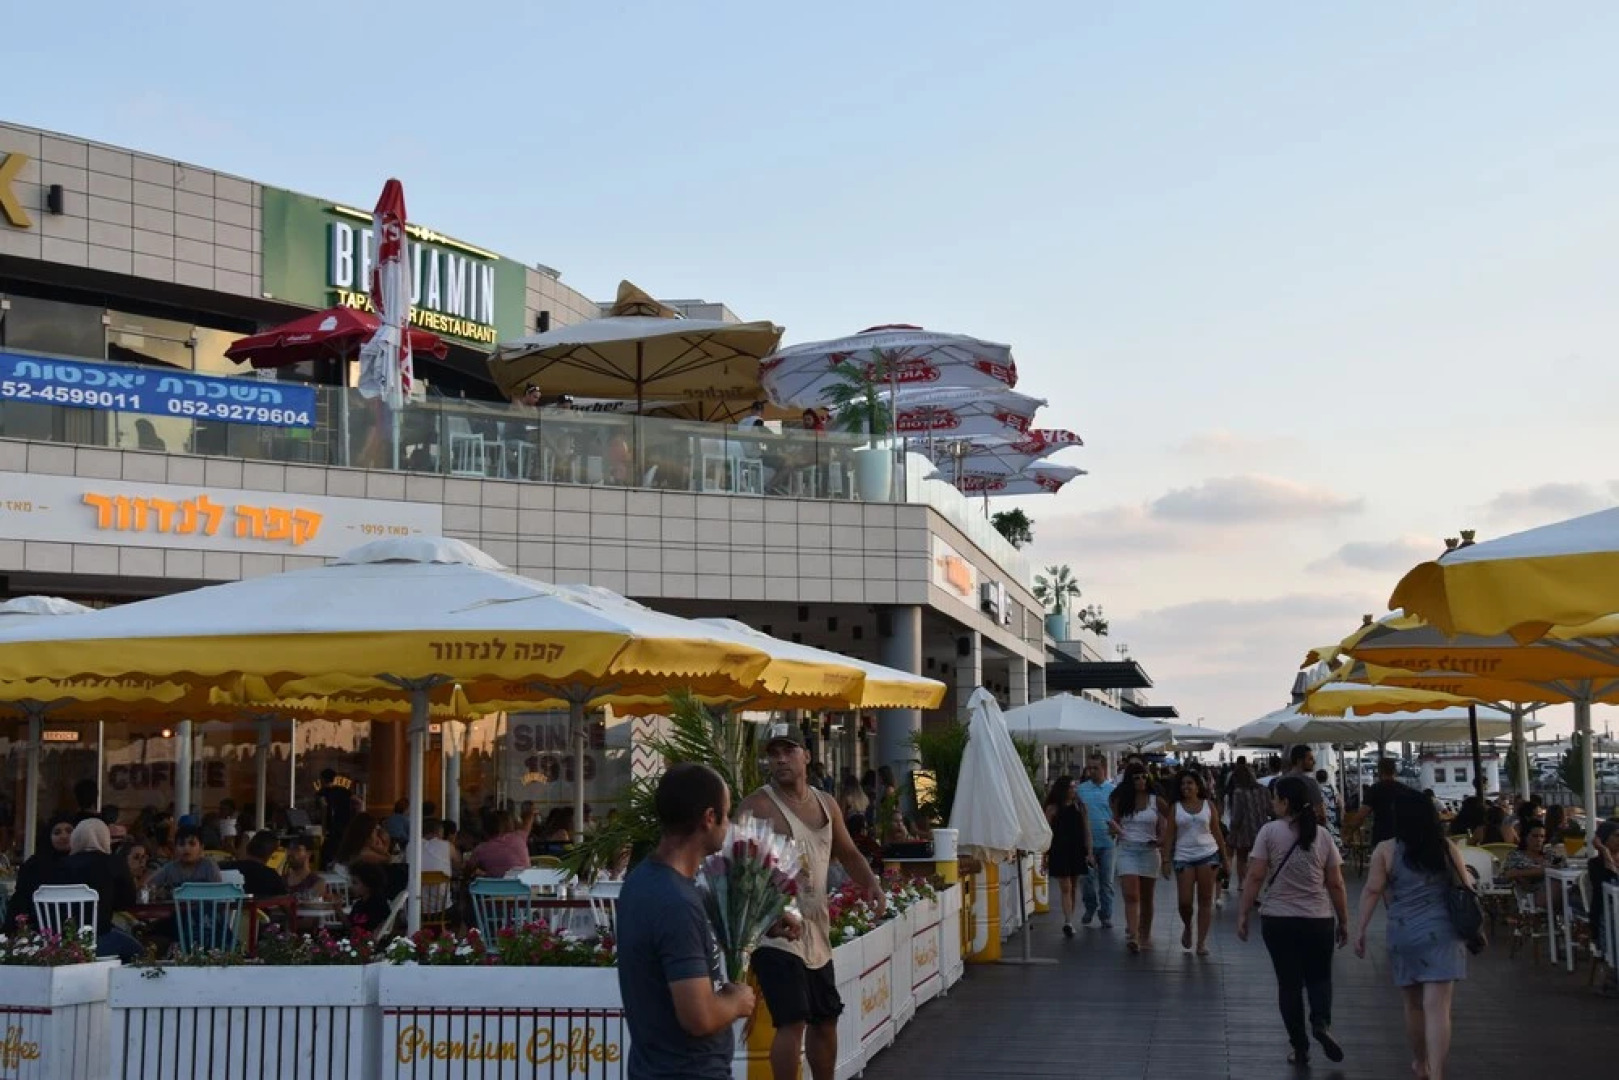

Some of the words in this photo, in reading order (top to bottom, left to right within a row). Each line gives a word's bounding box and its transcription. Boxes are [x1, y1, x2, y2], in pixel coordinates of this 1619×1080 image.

[330, 221, 496, 327] BEJAMIN
[12, 360, 146, 389] יאכטות
[157, 376, 283, 405] השכרת
[167, 399, 310, 426] 052-9279604
[83, 493, 226, 537] לנדוור
[234, 504, 324, 546] קפה
[360, 523, 384, 535] 1919
[387, 526, 409, 536] מאז
[429, 636, 508, 661] לנדוור
[513, 641, 565, 663] קפה
[397, 1024, 518, 1064] Premium
[525, 1027, 621, 1073] Coffee
